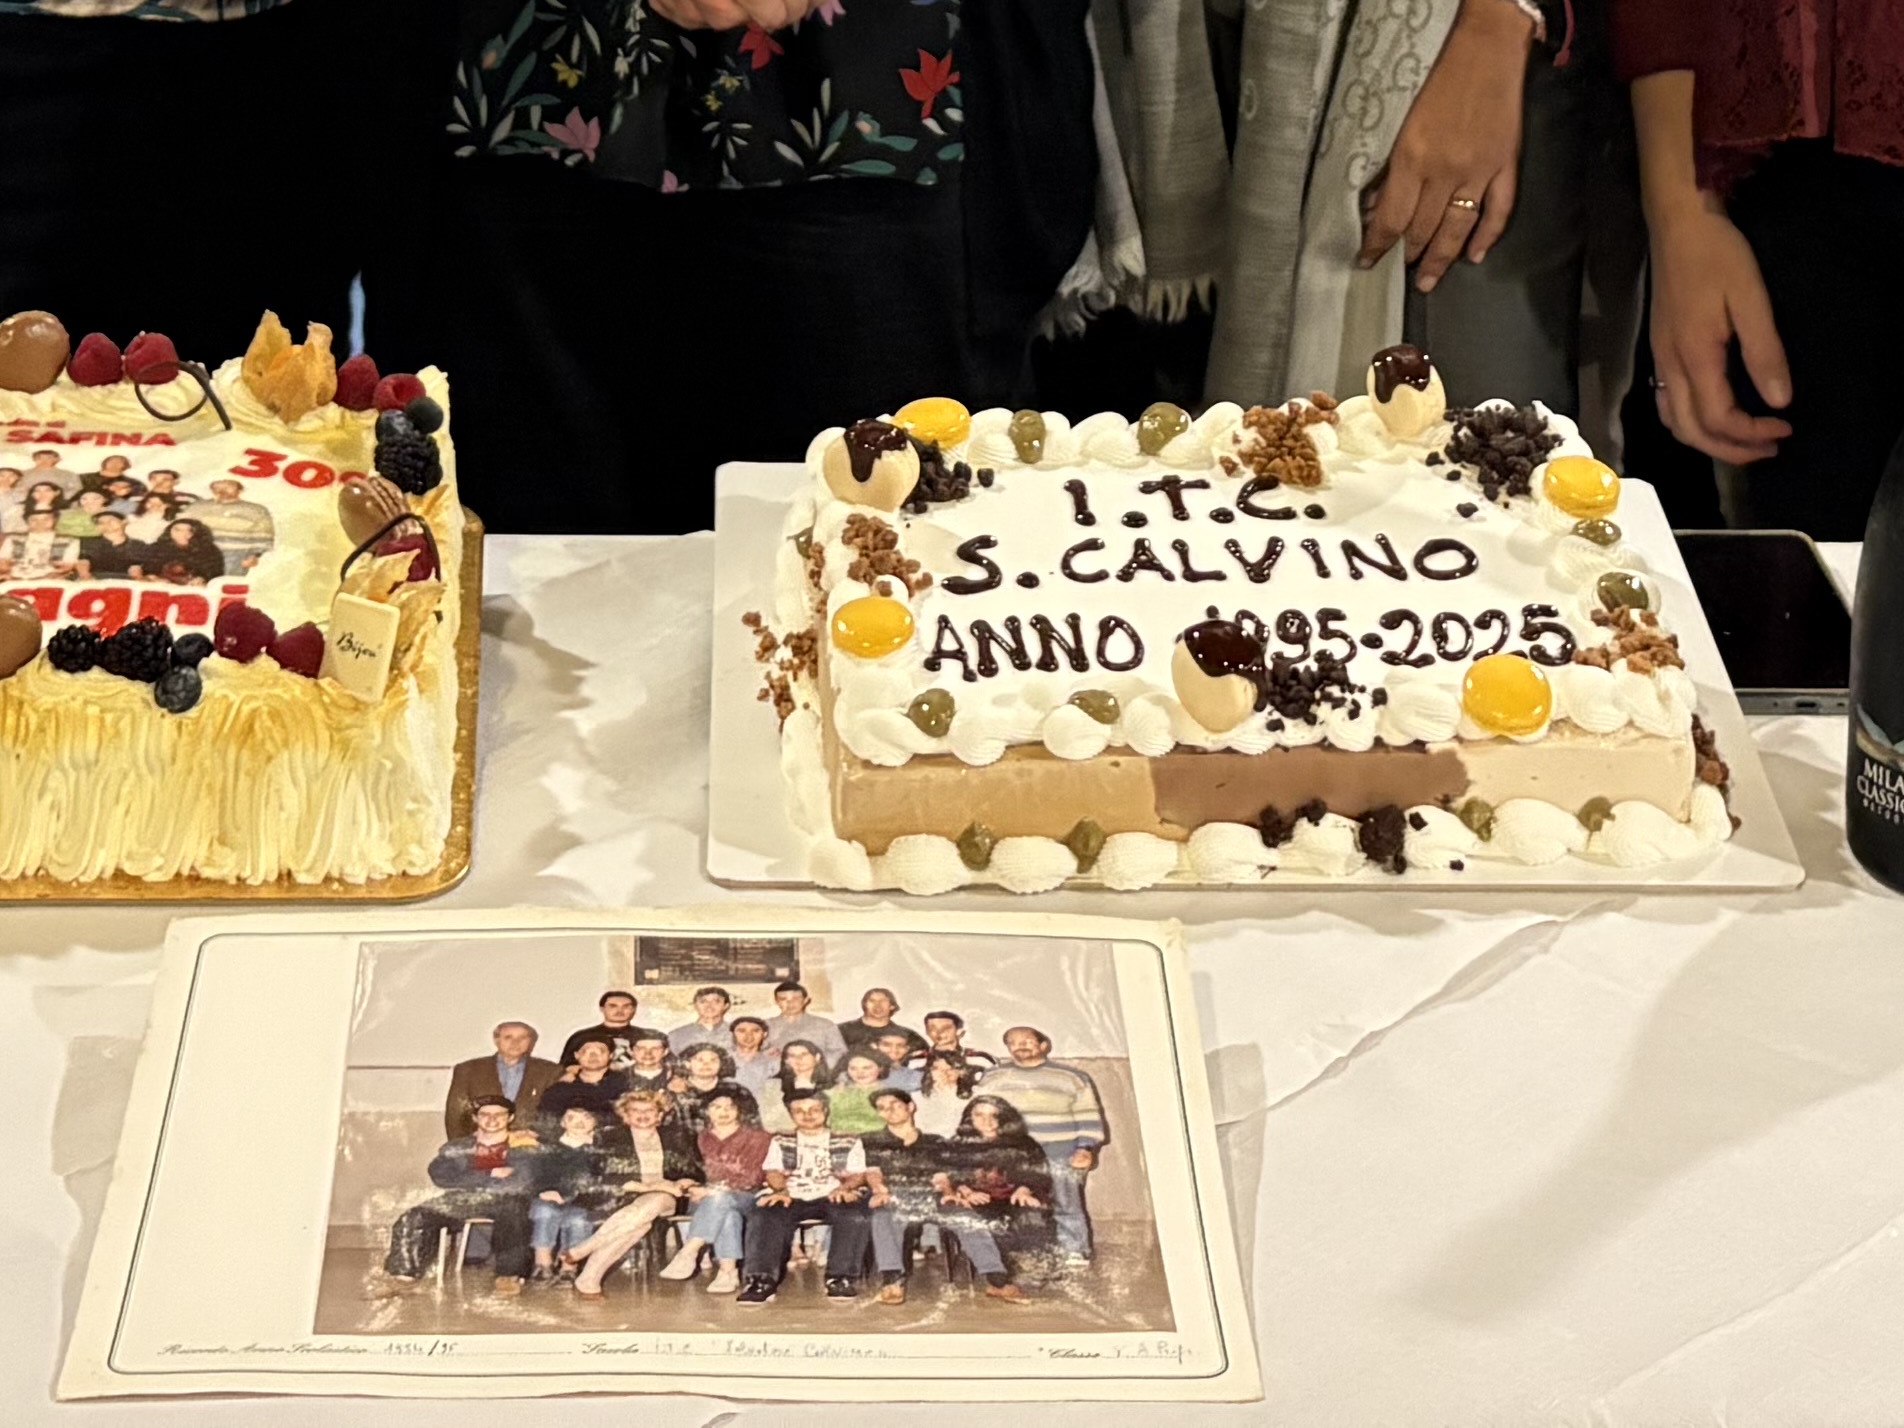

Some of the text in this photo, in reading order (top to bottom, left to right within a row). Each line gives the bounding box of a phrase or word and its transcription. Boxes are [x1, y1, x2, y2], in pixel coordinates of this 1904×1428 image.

[6, 428, 178, 447] SAFINA
[1059, 533, 1480, 584] CALVINO
[924, 604, 1577, 682] ANNO 995-2025
